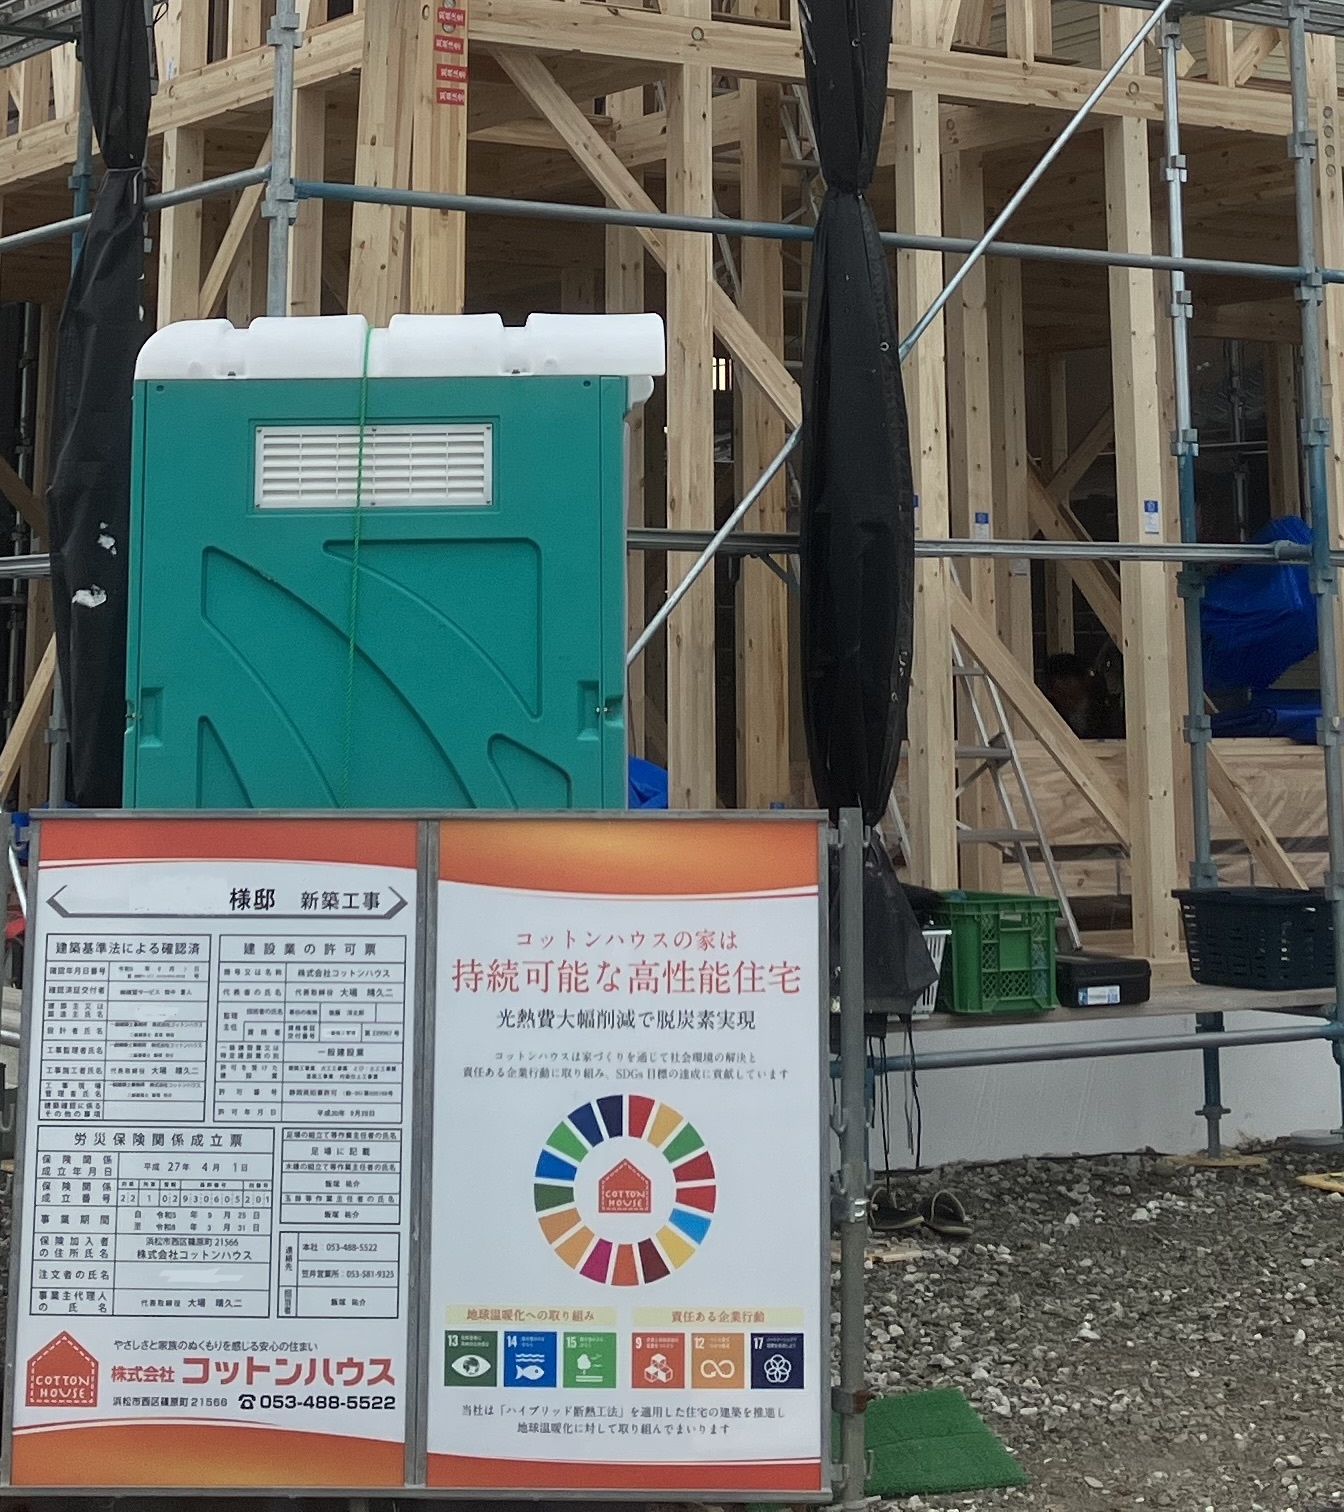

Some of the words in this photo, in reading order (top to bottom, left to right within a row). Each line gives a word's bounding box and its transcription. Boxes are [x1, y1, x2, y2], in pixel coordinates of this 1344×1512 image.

[230, 888, 275, 911] 様邸
[301, 892, 380, 910] 新築工事
[517, 929, 738, 950] コットンハウスの家は
[56, 942, 200, 955] 建築基準法による確認済
[244, 943, 376, 955] 建設業の許可票
[298, 969, 390, 977] 株式会社コットンハウス
[452, 958, 801, 995] 持続可能な高性能住宅
[497, 1009, 756, 1030] 光熱費大幅削減で脱炭素実現
[495, 1051, 757, 1064] コットンハウスは家づくりを通じて社会環境の解決と
[74, 1133, 243, 1147] 労災保険関係成立票
[311, 1147, 371, 1156] 足場に記載
[42, 1167, 112, 1177] 成立年月日
[144, 1162, 159, 1172] 平成
[168, 1162, 189, 1172] 27年
[605, 1190, 645, 1198] COTTON
[609, 1199, 642, 1207] HOUSE
[41, 1215, 110, 1225] 事業期間
[39, 1249, 108, 1259] の住所氏名
[137, 1250, 252, 1261] 株式会社コットンハウス
[39, 1270, 110, 1280] 注文者の氏名
[39, 1291, 107, 1301] 事業主代理人
[39, 1303, 107, 1312] の氏名
[466, 1308, 595, 1322] 地球温暖化への取り組み
[672, 1311, 765, 1324] 責任ある企業行動
[114, 1340, 318, 1352] やさしさと家族のぬくもりを感じる安心の住まい
[448, 1335, 459, 1346] 13
[507, 1336, 517, 1347] 14
[566, 1337, 577, 1348] 15
[635, 1337, 642, 1349] 9
[694, 1337, 704, 1349] 12
[753, 1337, 763, 1349] 17
[110, 1366, 175, 1383] 株式会社
[182, 1356, 396, 1387] コットンハウス
[35, 1375, 90, 1387] COTTON
[40, 1388, 85, 1399] HOUSE
[260, 1395, 396, 1410] 053-488-5522
[516, 1422, 730, 1435] 地球温暖化に対して取り組んでまいります
